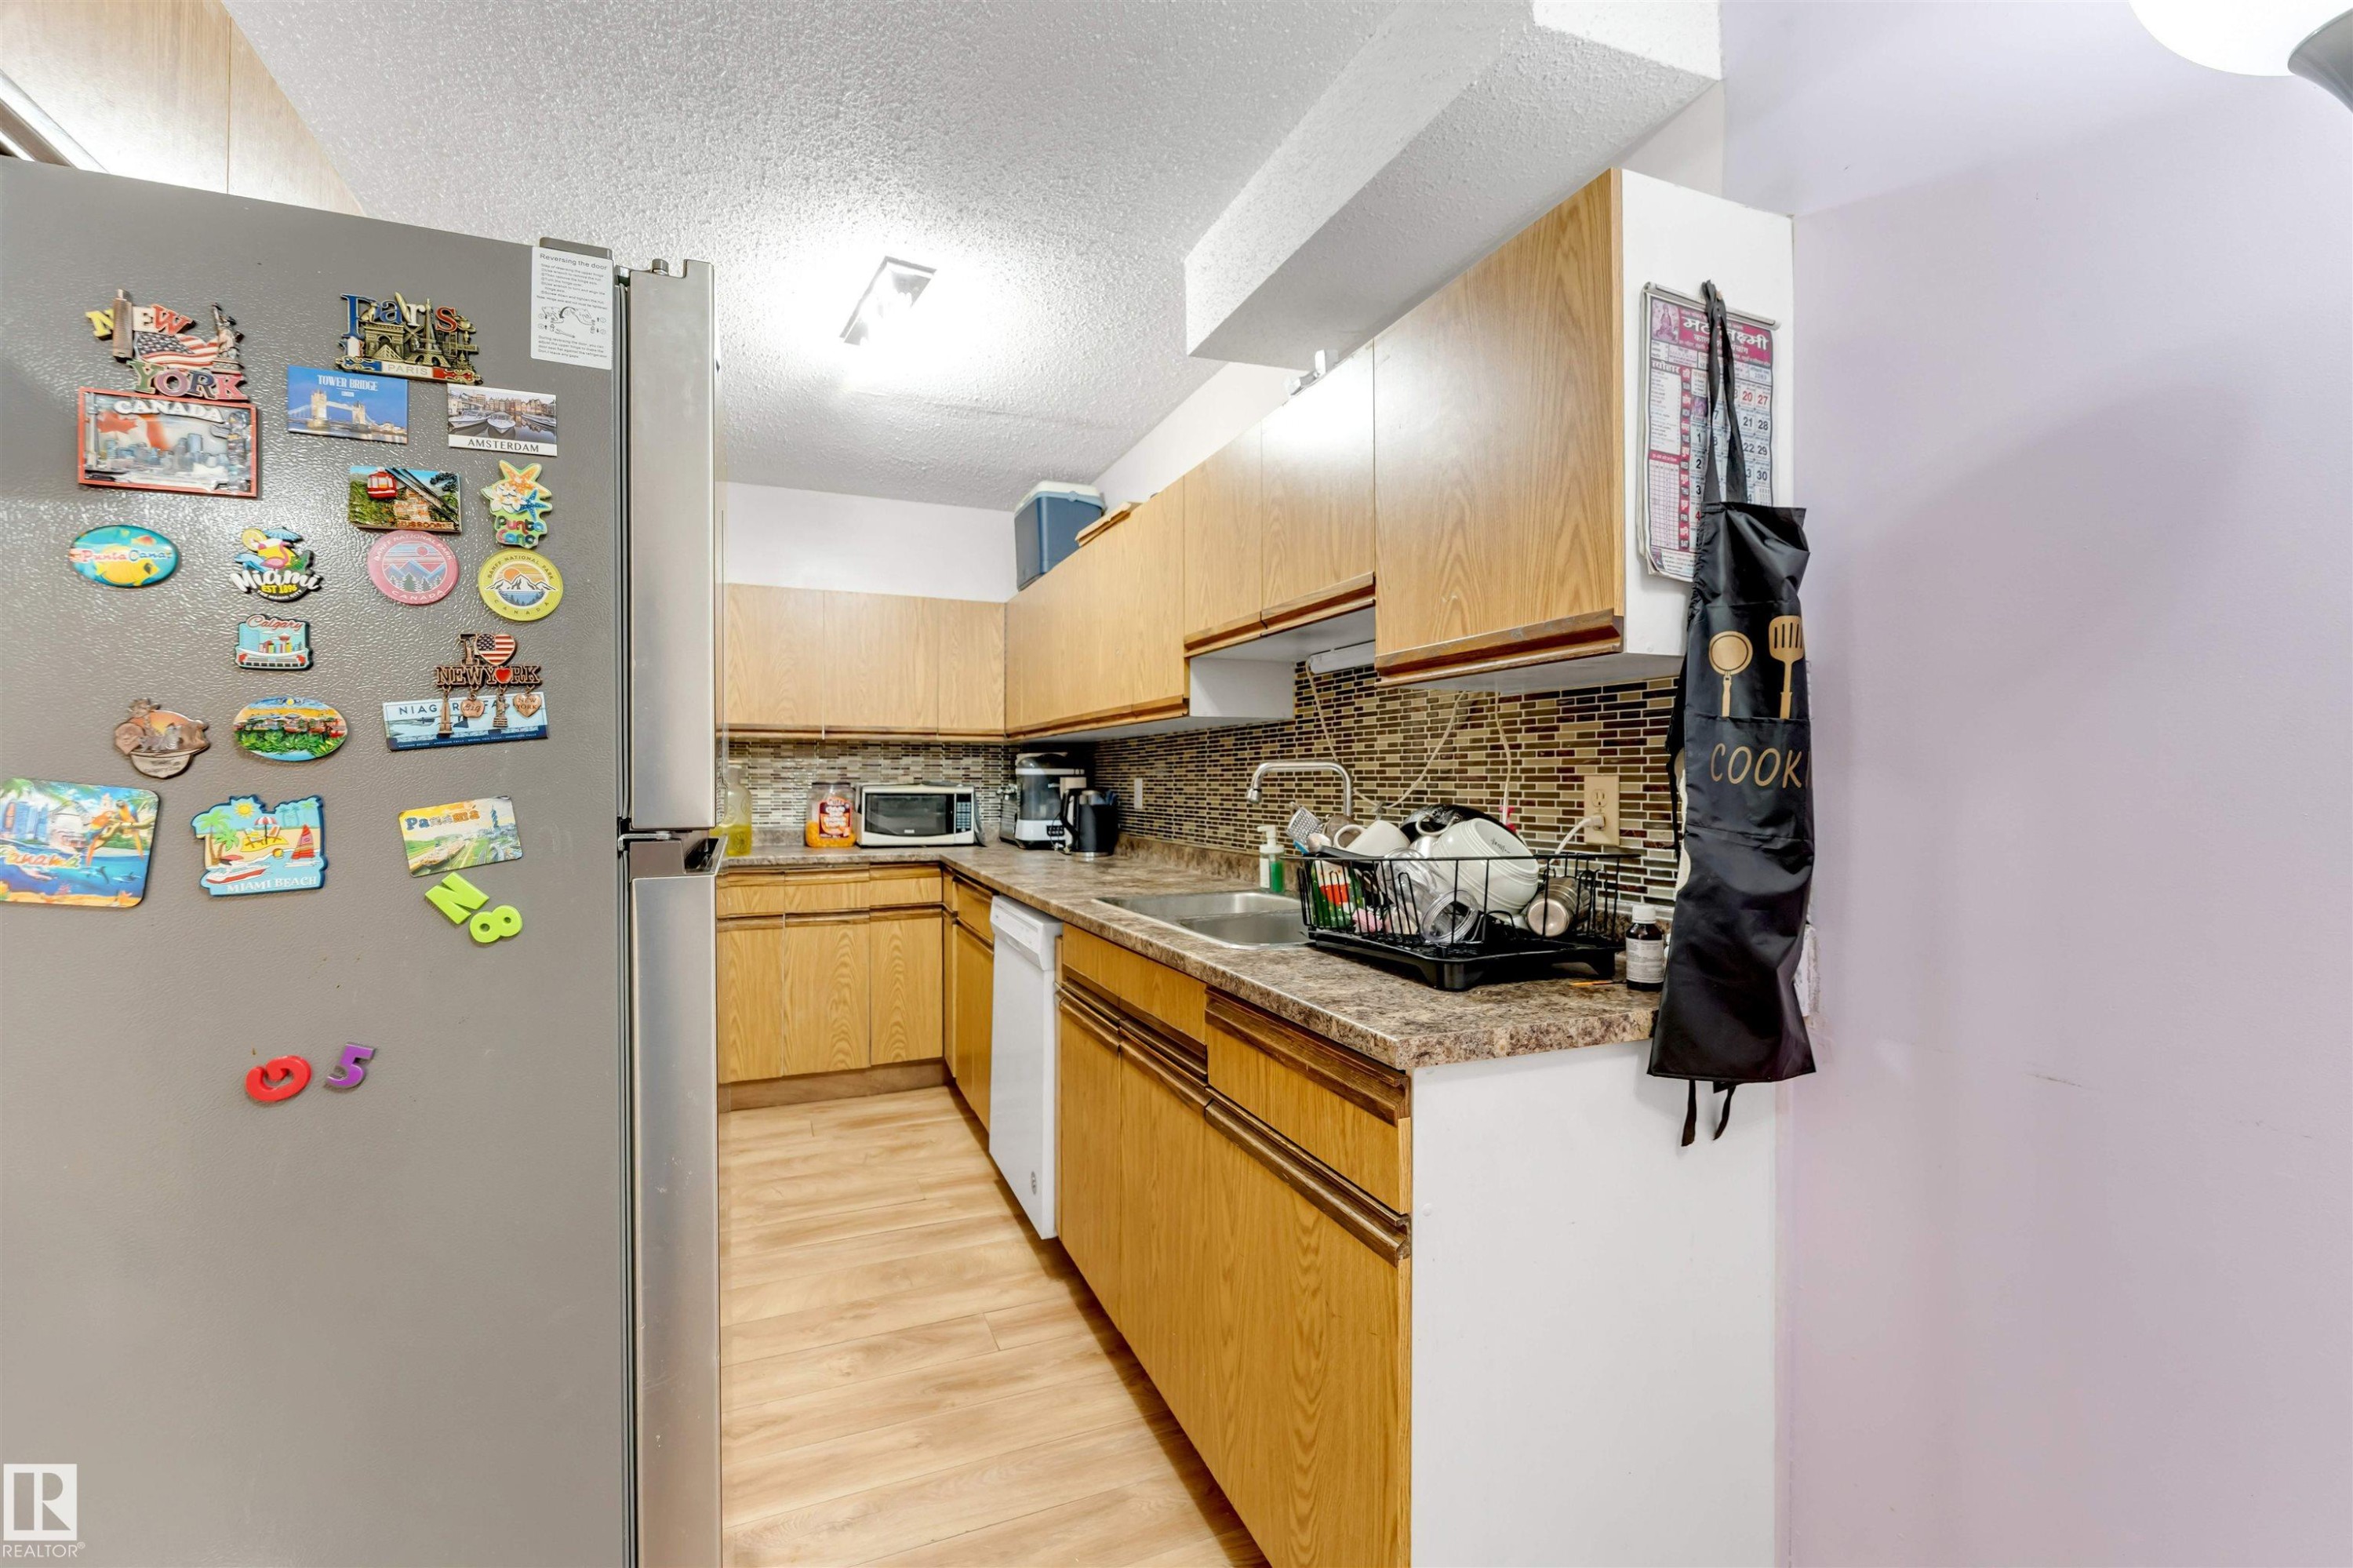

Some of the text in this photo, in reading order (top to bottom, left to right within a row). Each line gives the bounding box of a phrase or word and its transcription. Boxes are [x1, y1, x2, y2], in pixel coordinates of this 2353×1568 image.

[540, 253, 576, 267] Reversing
[85, 304, 194, 337] NEW
[387, 363, 428, 376] PARIS
[127, 359, 249, 400] YORK
[317, 374, 378, 391] TOWER BRIDGE
[1743, 391, 1753, 402] 20
[1758, 395, 1768, 406] 27
[114, 399, 226, 424] CANADA
[1713, 409, 1769, 431] 7 21 28
[467, 438, 540, 453] AMSTERDAM
[1743, 442, 1755, 453] 22
[1758, 445, 1768, 456] 29
[1696, 459, 1701, 469] 2
[1757, 471, 1768, 481] 30
[1696, 486, 1701, 495] 3
[1696, 511, 1701, 521] 4
[496, 515, 545, 535] Punta
[496, 529, 536, 544] Cana
[82, 549, 127, 562] Punta
[375, 533, 453, 562] BANFF NATIONAL PARK
[487, 555, 555, 580] BANFF NATIONAL PARK
[230, 569, 321, 592] Miami
[260, 584, 278, 594] EST
[392, 590, 445, 601] CANADA
[494, 598, 550, 615] CANADA
[246, 614, 305, 631] Calgary
[463, 704, 481, 713] Big
[1710, 743, 1802, 789] COOK
[227, 876, 318, 893] MIAMI BEACH
[470, 904, 523, 944] 8
[326, 1042, 374, 1088] 5
